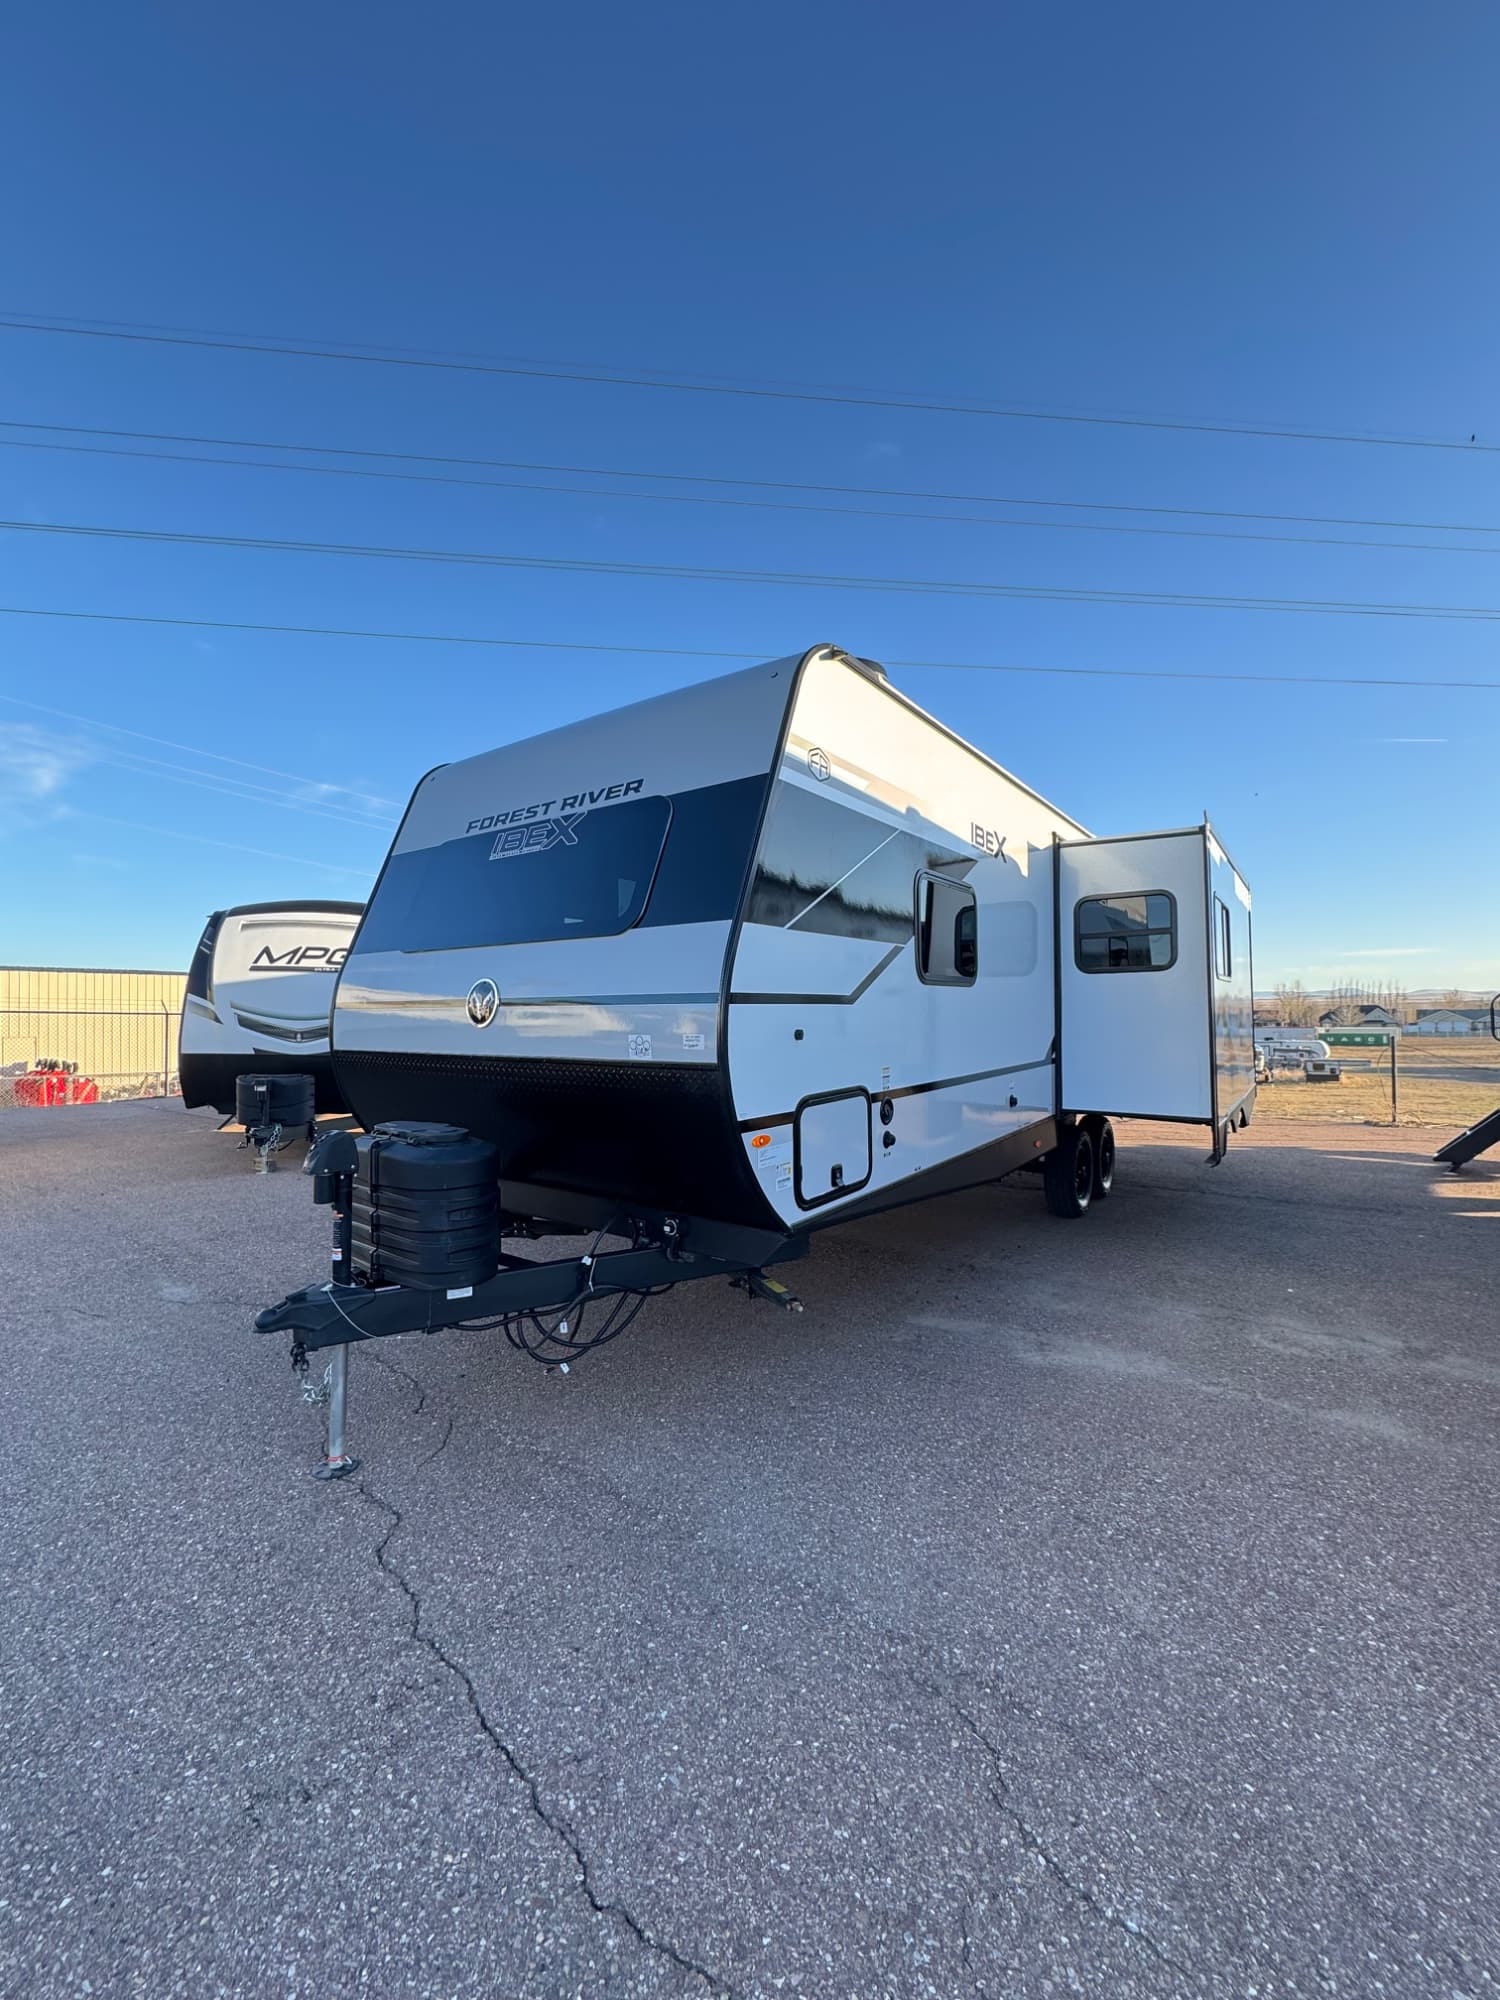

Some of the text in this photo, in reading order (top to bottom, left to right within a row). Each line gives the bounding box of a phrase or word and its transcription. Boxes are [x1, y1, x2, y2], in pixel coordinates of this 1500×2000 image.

[465, 778, 644, 834] FOREST RIVER
[489, 811, 588, 858] IBEX
[970, 821, 1007, 864] IBEX
[252, 945, 348, 966] MPG
